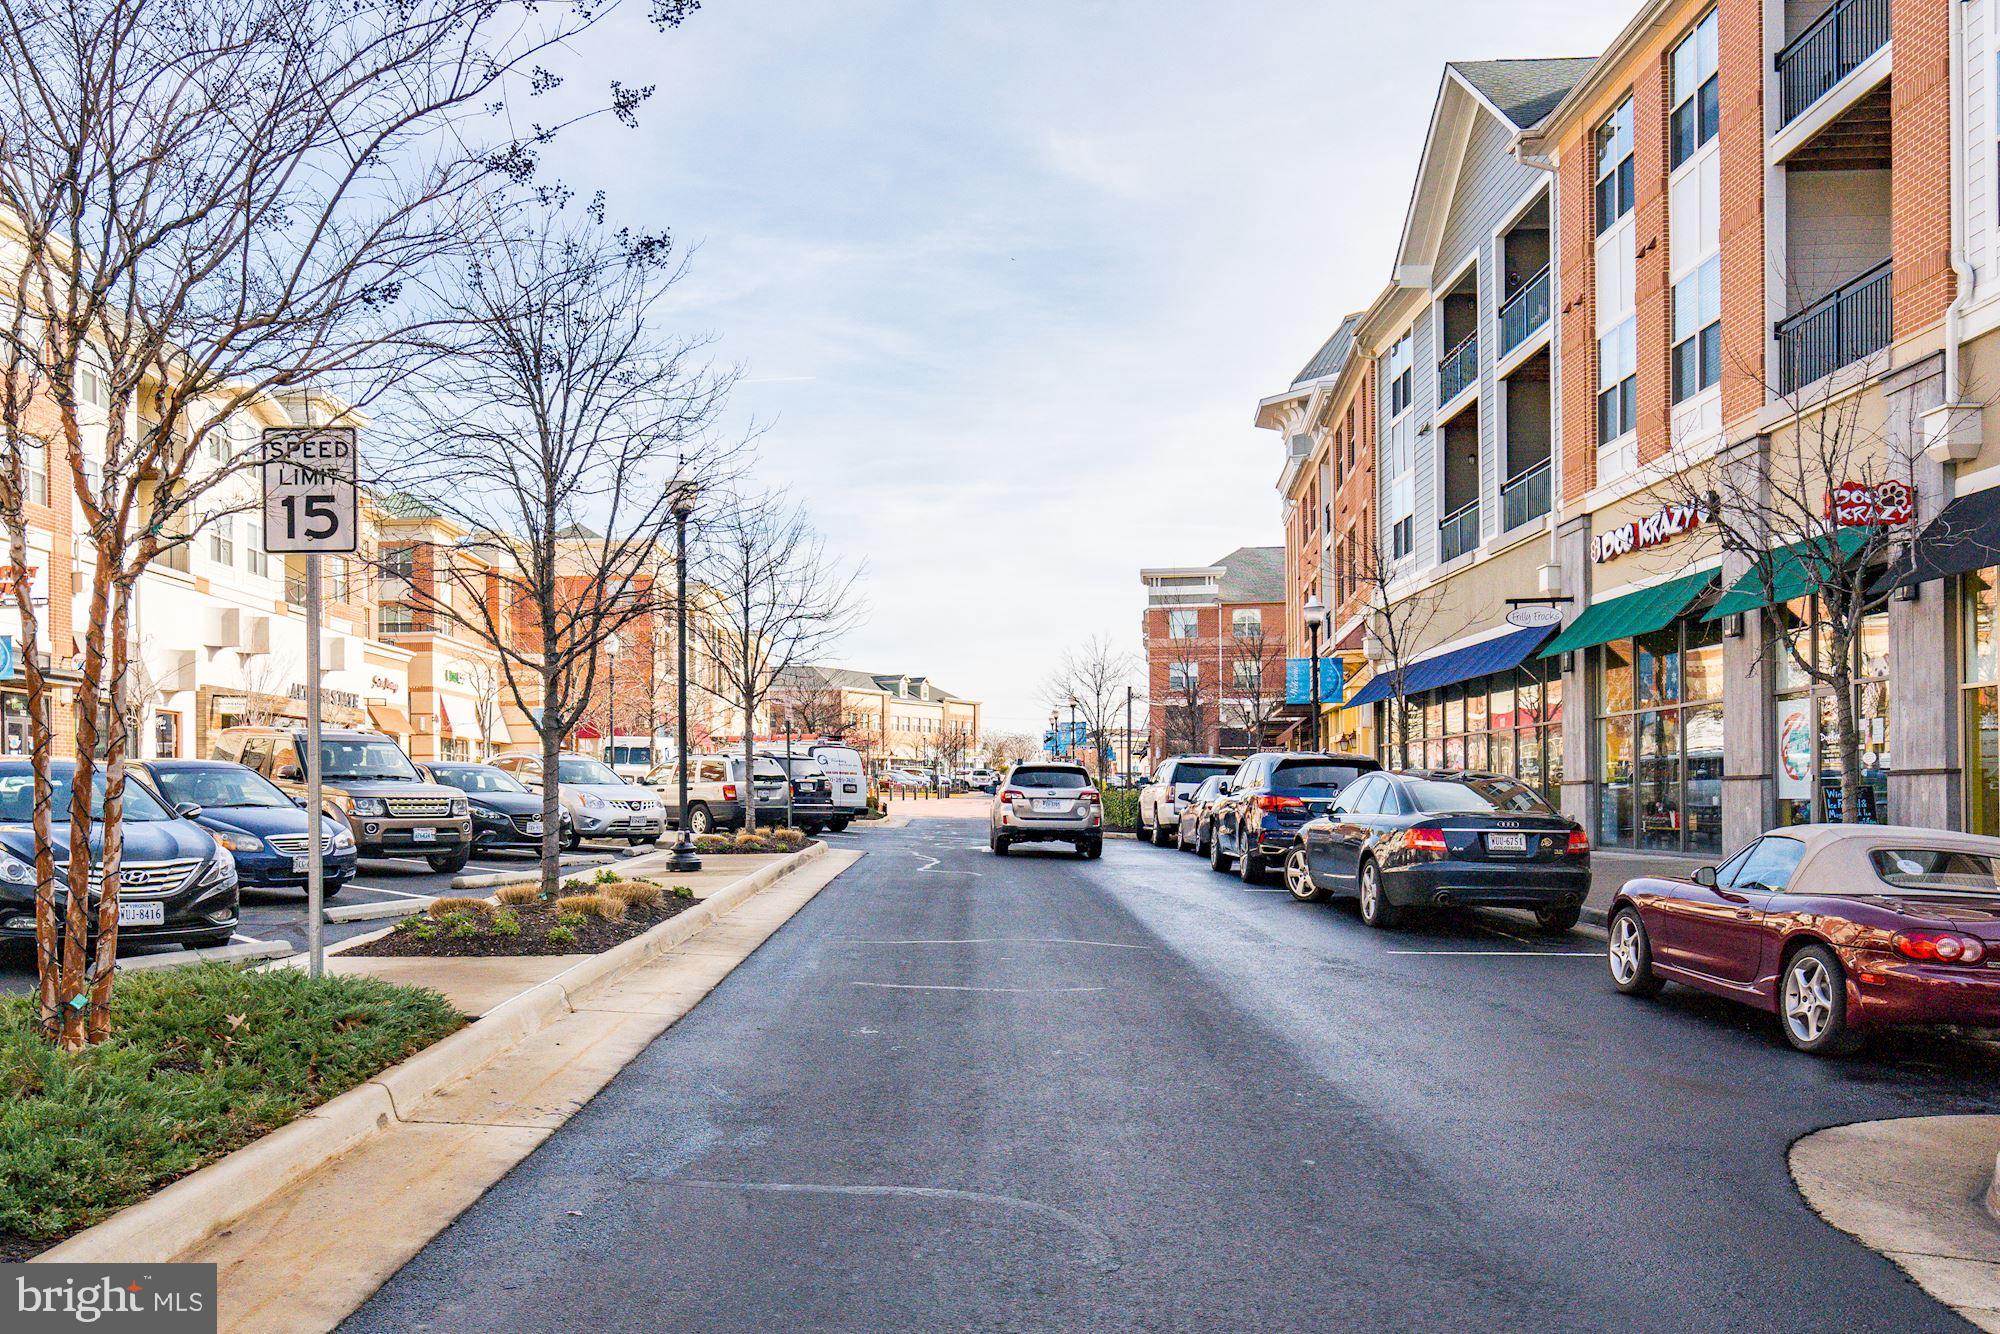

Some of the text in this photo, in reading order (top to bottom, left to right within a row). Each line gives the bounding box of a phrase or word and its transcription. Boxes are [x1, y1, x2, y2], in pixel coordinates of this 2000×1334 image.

[271, 442, 348, 458] SPEED
[280, 468, 340, 485] LIMIT
[281, 495, 339, 539] 15
[1836, 504, 1912, 521] KRAZY
[1601, 498, 1697, 561] DOG KRAZY
[1512, 611, 1560, 624] Frilly Frocks
[120, 909, 161, 920] WUJ-8416
